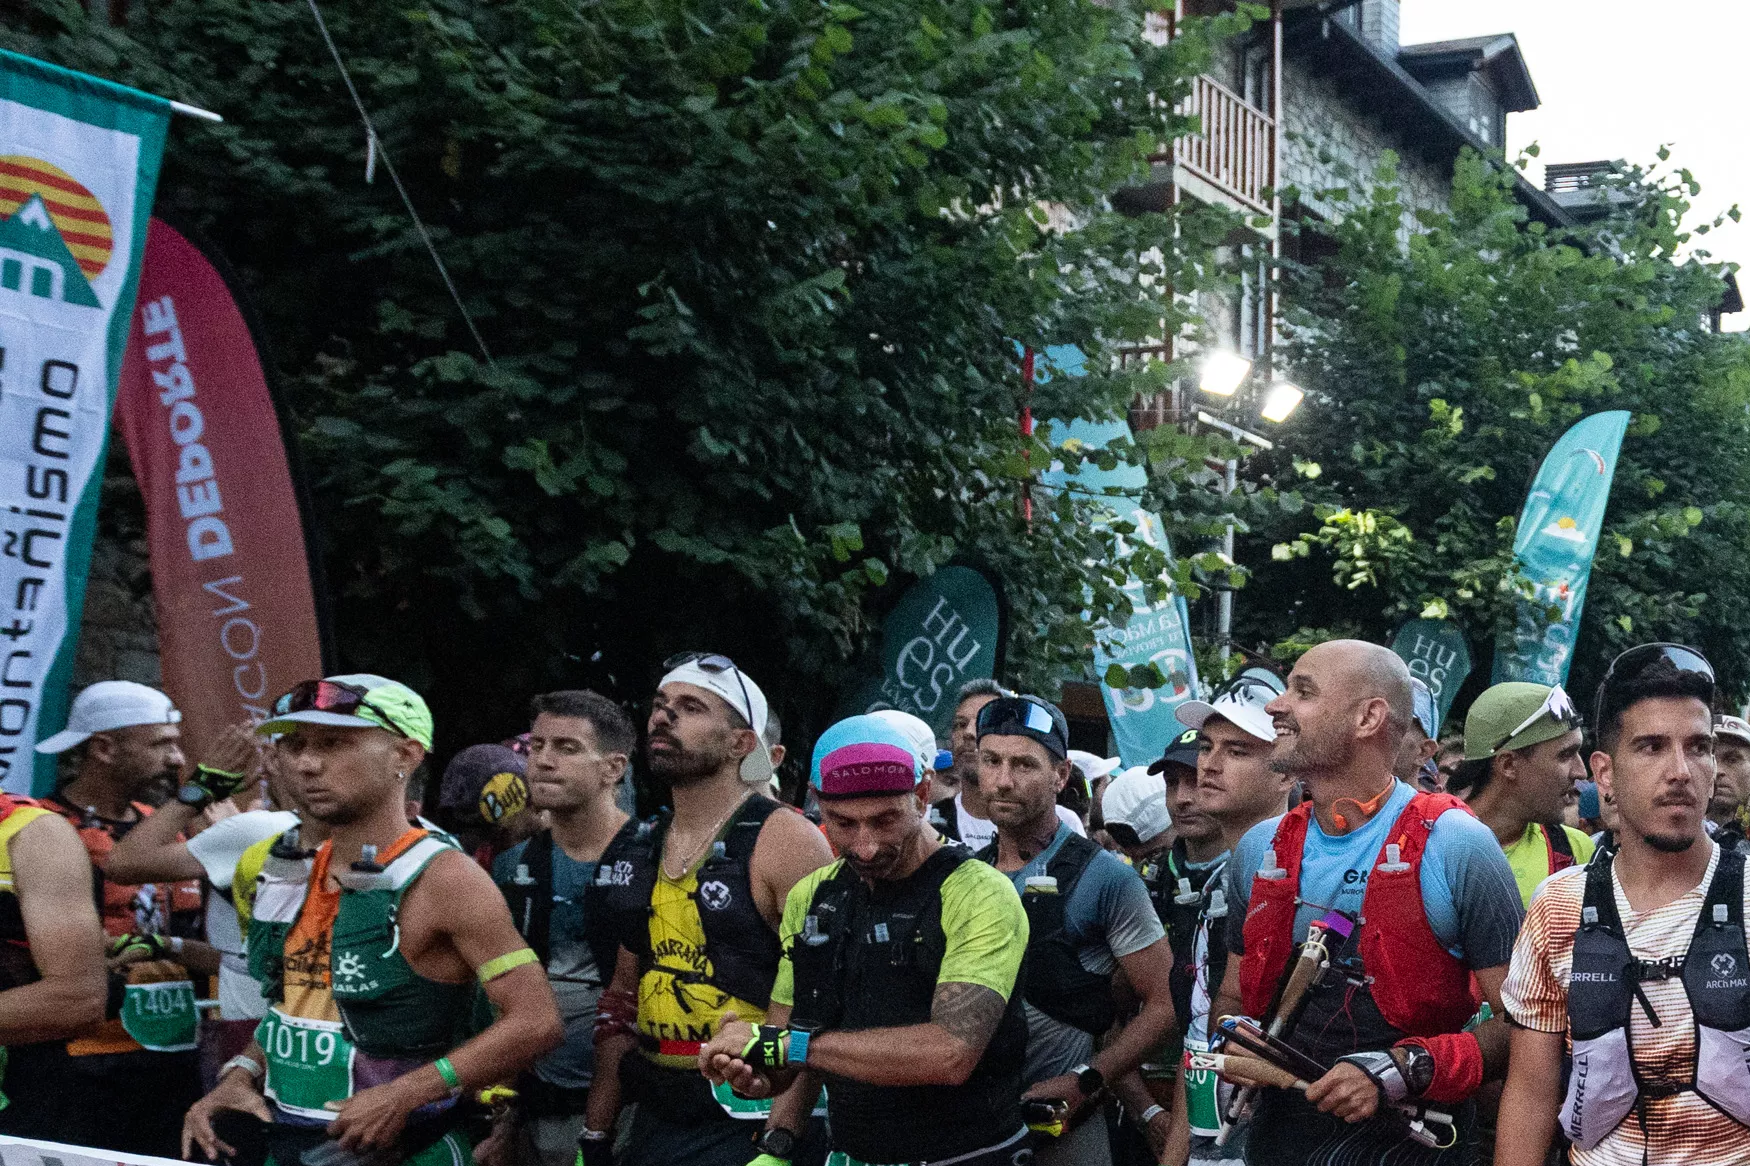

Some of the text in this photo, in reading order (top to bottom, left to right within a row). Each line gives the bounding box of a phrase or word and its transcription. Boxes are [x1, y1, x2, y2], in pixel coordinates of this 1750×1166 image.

[832, 765, 907, 778] SALOMON
[1571, 972, 1617, 982] ERRELL
[1730, 977, 1748, 987] MAX
[129, 988, 188, 1016] 1404
[266, 1020, 336, 1066] 1019
[763, 1041, 775, 1067] EKI
[1570, 1055, 1589, 1141] MERRELL
